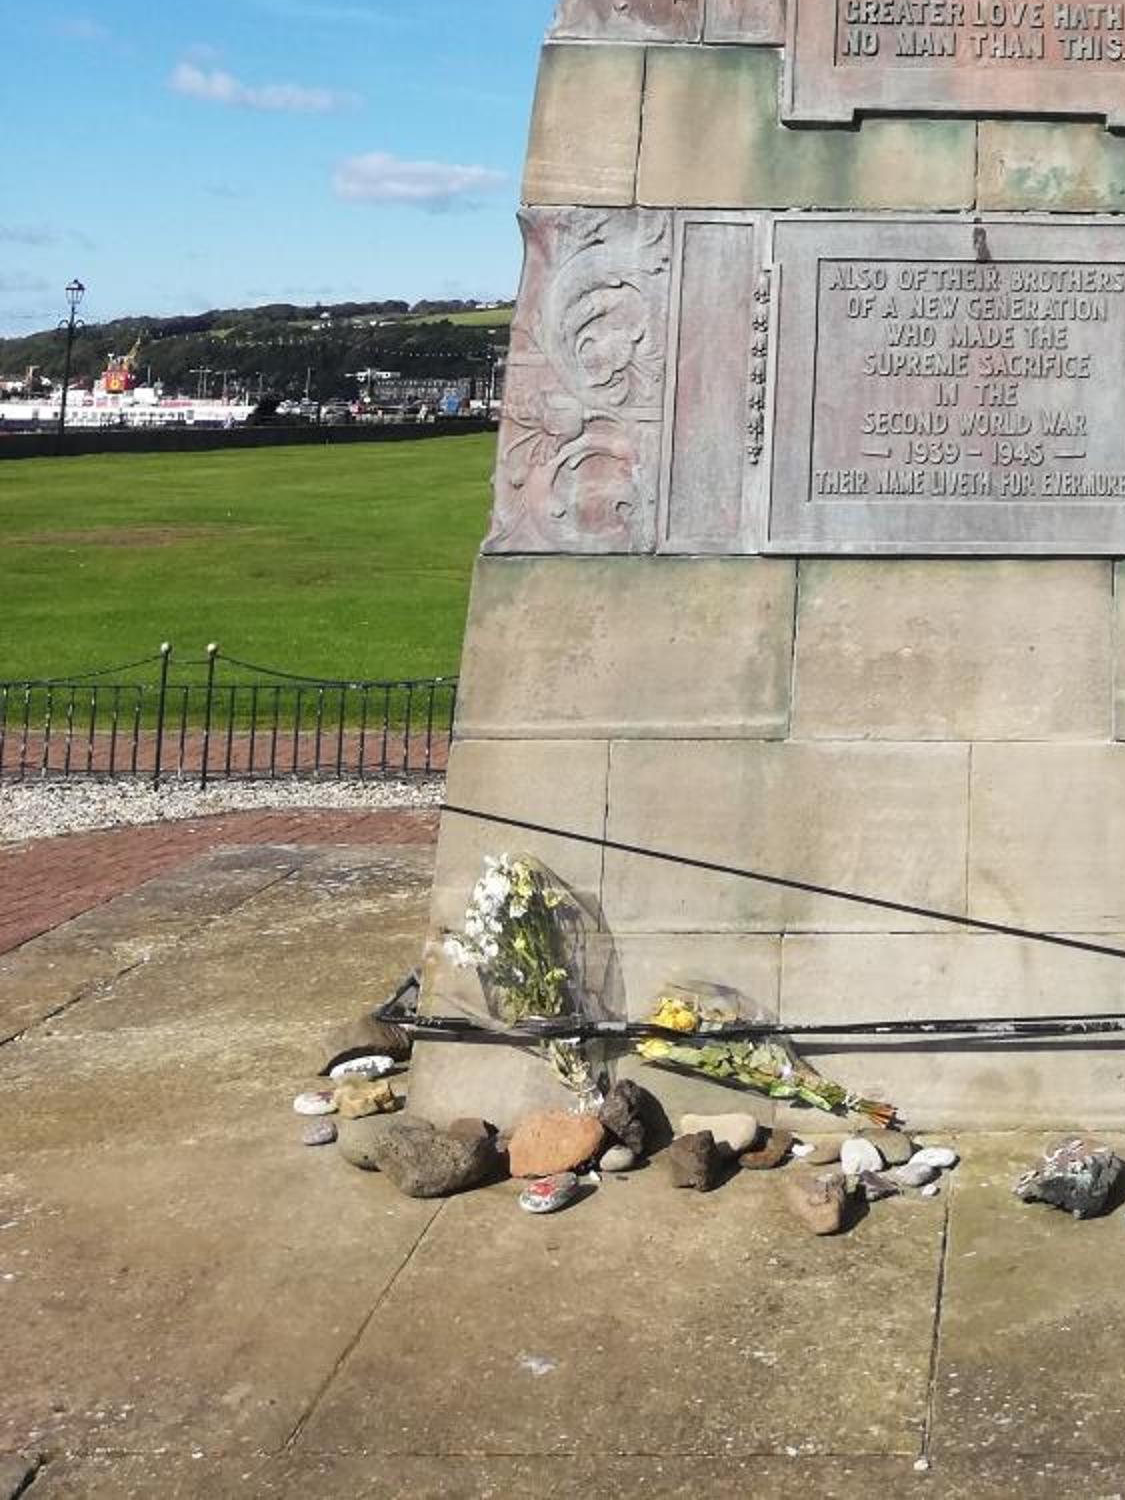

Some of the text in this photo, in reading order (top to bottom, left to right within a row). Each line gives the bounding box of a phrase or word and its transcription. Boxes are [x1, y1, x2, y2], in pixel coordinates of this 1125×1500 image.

[845, 0, 1125, 31] GREATER LOVE HATH
[842, 30, 880, 56] NO
[895, 32, 957, 57] MAN
[969, 33, 1045, 59] THAN
[828, 266, 1125, 293] ALSO OF THEIR BROTHERS
[847, 296, 1107, 322] OF A NEW GENERATION
[886, 324, 1069, 350] WHO MADE THE
[863, 352, 1092, 379] SUPREME SACRIFICE
[935, 383, 1019, 407] IN THE
[863, 411, 1088, 437] SECOND WORLD WAR
[903, 440, 960, 465] 1939
[816, 468, 868, 495] THEIR
[876, 469, 925, 495] NAME
[930, 470, 993, 497] LIVETH
[1001, 471, 1036, 497] FOR
